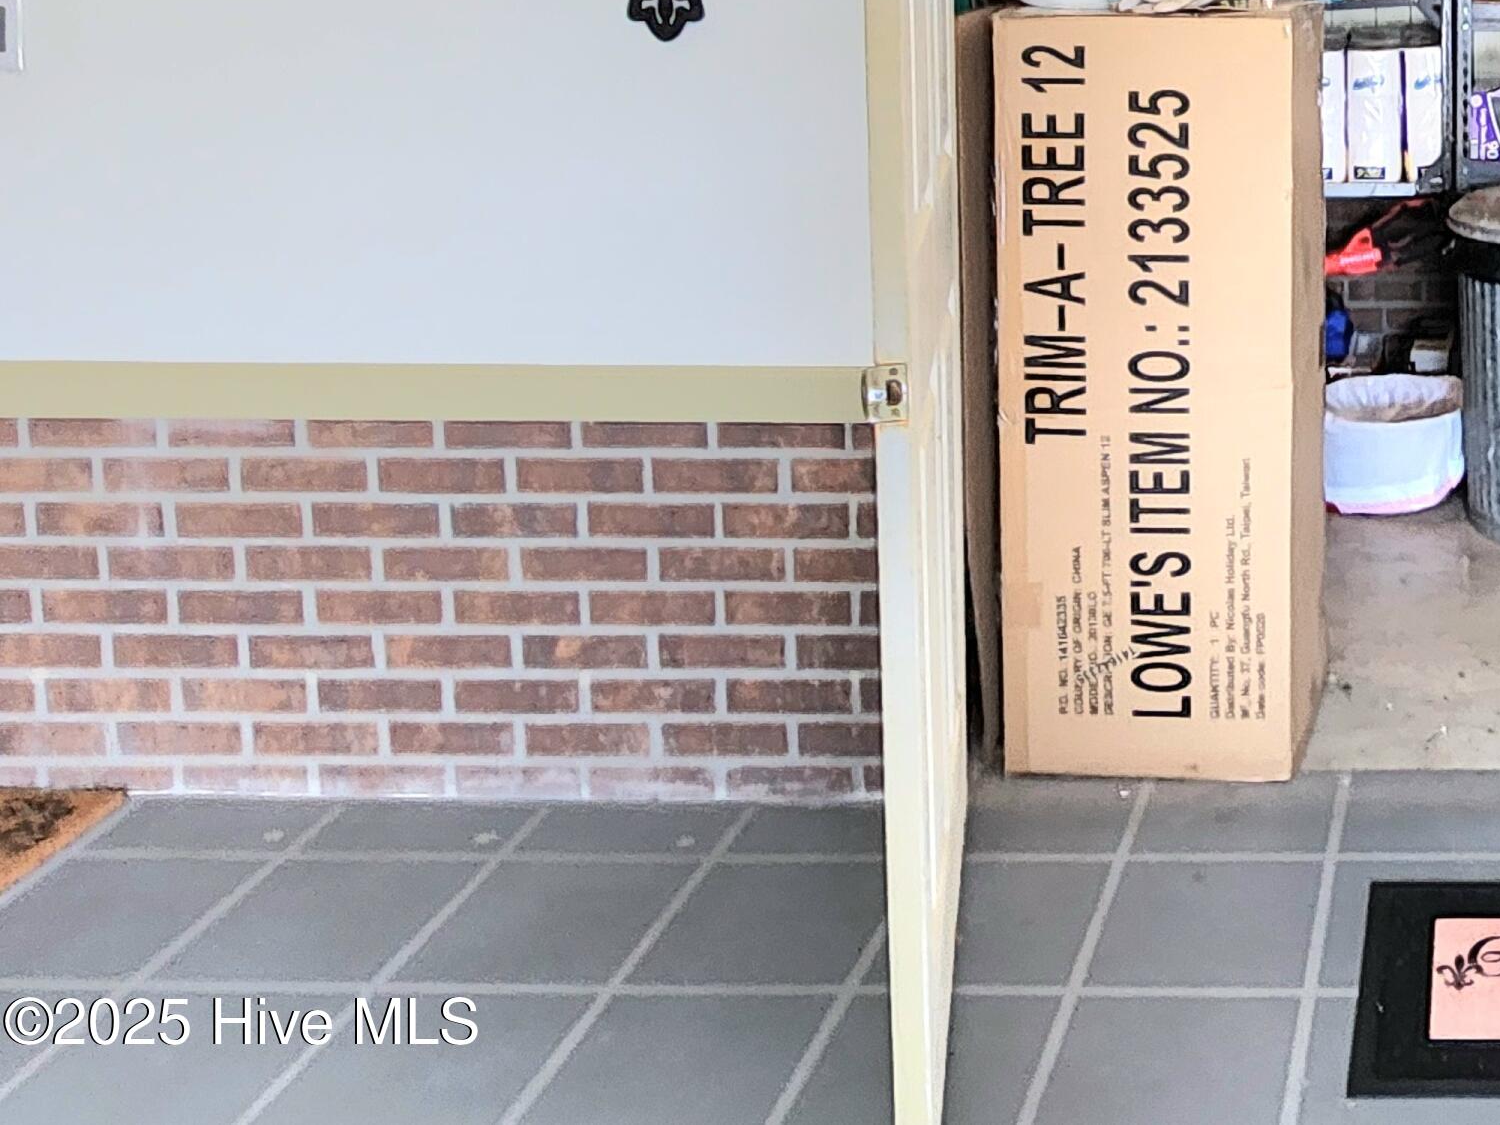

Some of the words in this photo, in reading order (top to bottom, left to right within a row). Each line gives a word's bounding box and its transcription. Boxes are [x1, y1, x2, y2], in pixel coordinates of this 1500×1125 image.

[1021, 44, 1086, 93] 12
[1127, 88, 1191, 308] 2133525
[1100, 453, 1111, 495] ASPEN
[1128, 433, 1191, 533] ITEM
[1072, 546, 1082, 584] CHINA
[1224, 540, 1237, 584] Holiday
[1239, 570, 1251, 601] North
[1129, 552, 1192, 719] LOWE'S
[1209, 611, 1220, 628] PC
[1072, 638, 1083, 653] OF
